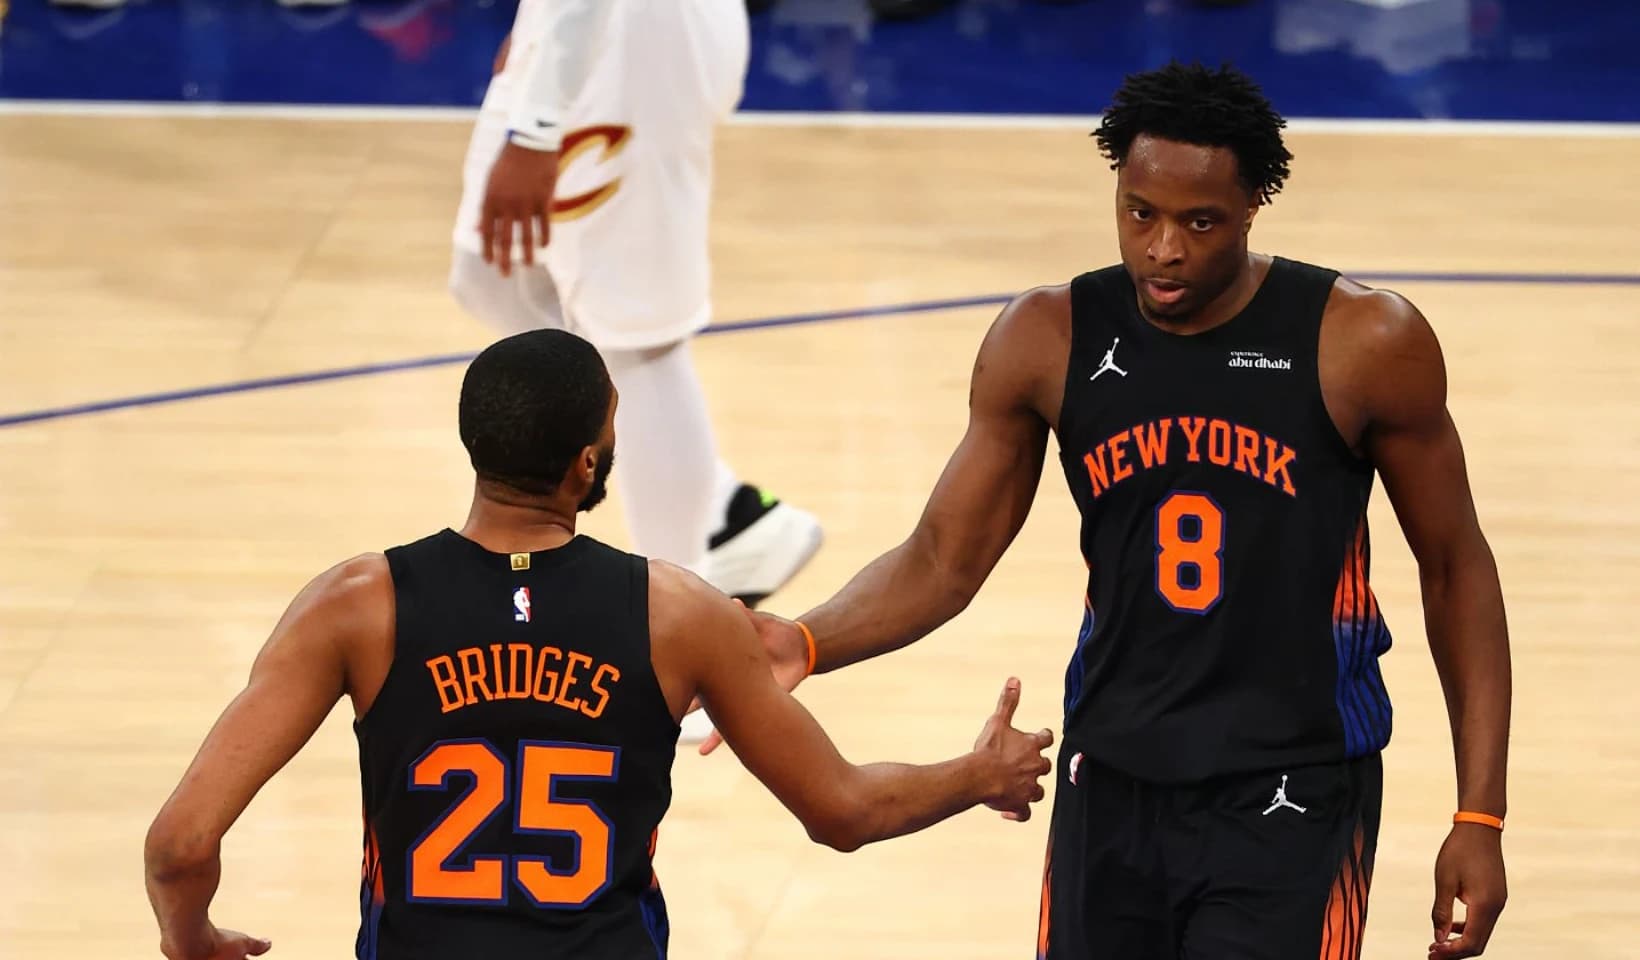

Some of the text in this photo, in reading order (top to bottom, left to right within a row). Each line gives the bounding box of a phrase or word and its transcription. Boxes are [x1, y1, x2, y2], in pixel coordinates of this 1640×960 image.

[1228, 356, 1292, 370] abu dhabi
[1083, 416, 1297, 498] NEW YORK
[1154, 489, 1226, 616] 8
[425, 642, 621, 719] BRIDGES
[406, 737, 622, 910] 25
